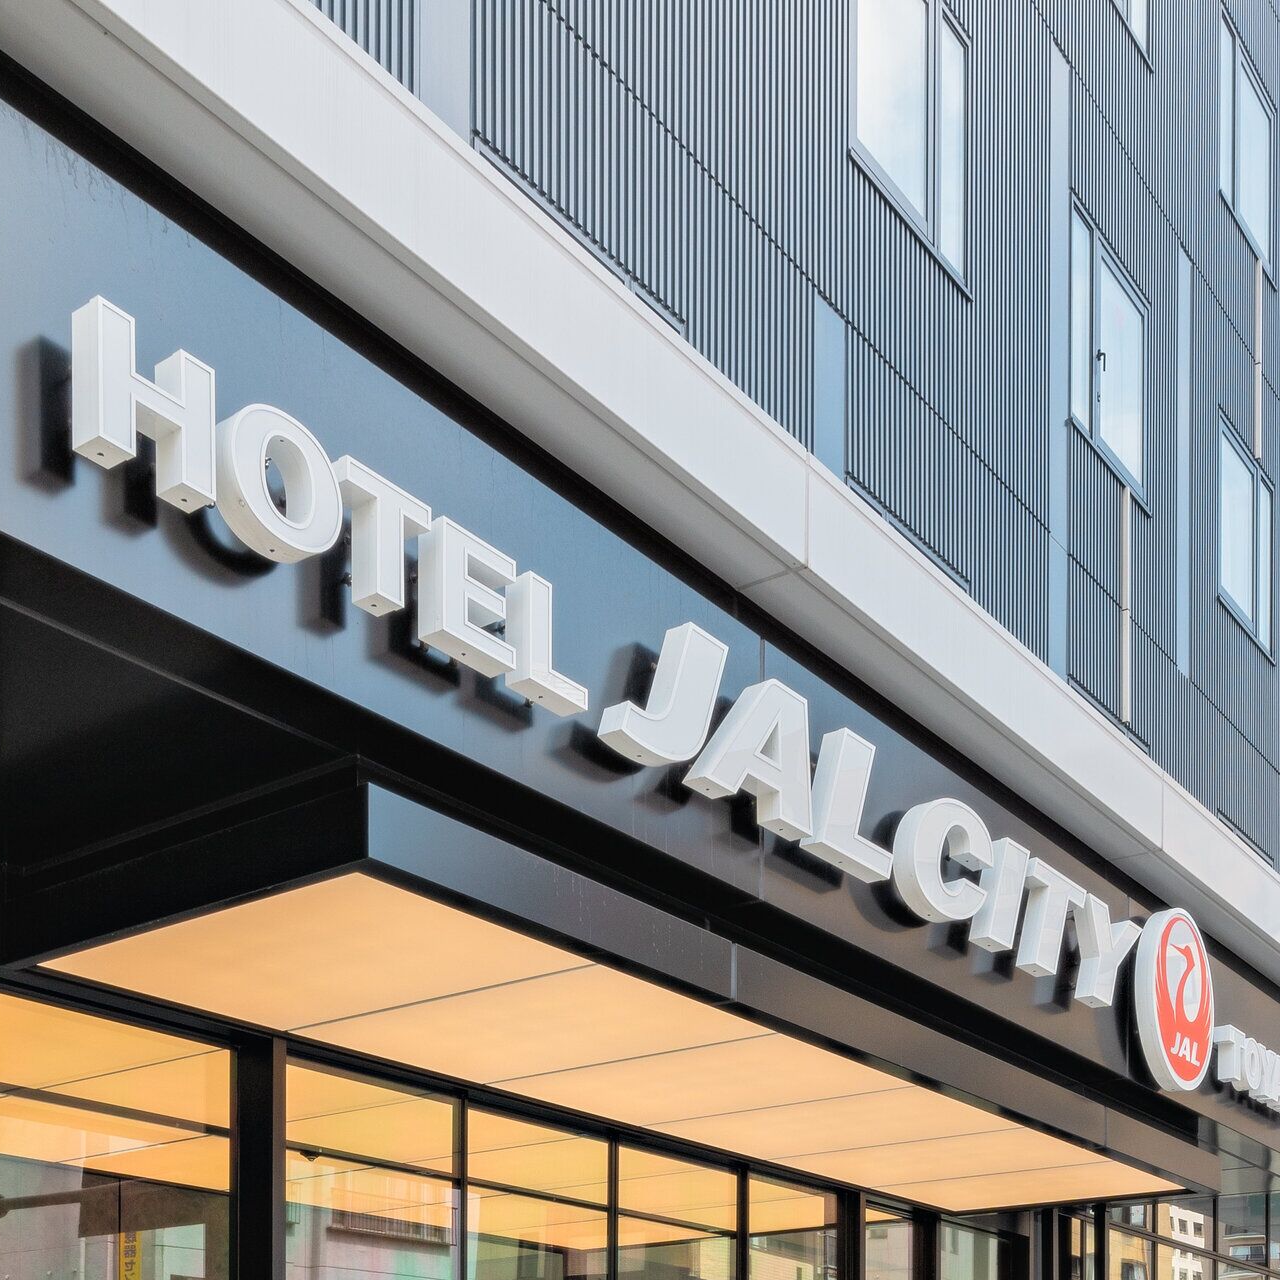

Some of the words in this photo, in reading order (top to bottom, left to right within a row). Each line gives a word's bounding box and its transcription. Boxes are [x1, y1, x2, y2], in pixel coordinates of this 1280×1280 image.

[71, 295, 588, 717] HOTEL
[598, 621, 1141, 1009] JALCITY
[1169, 1031, 1201, 1067] JAL
